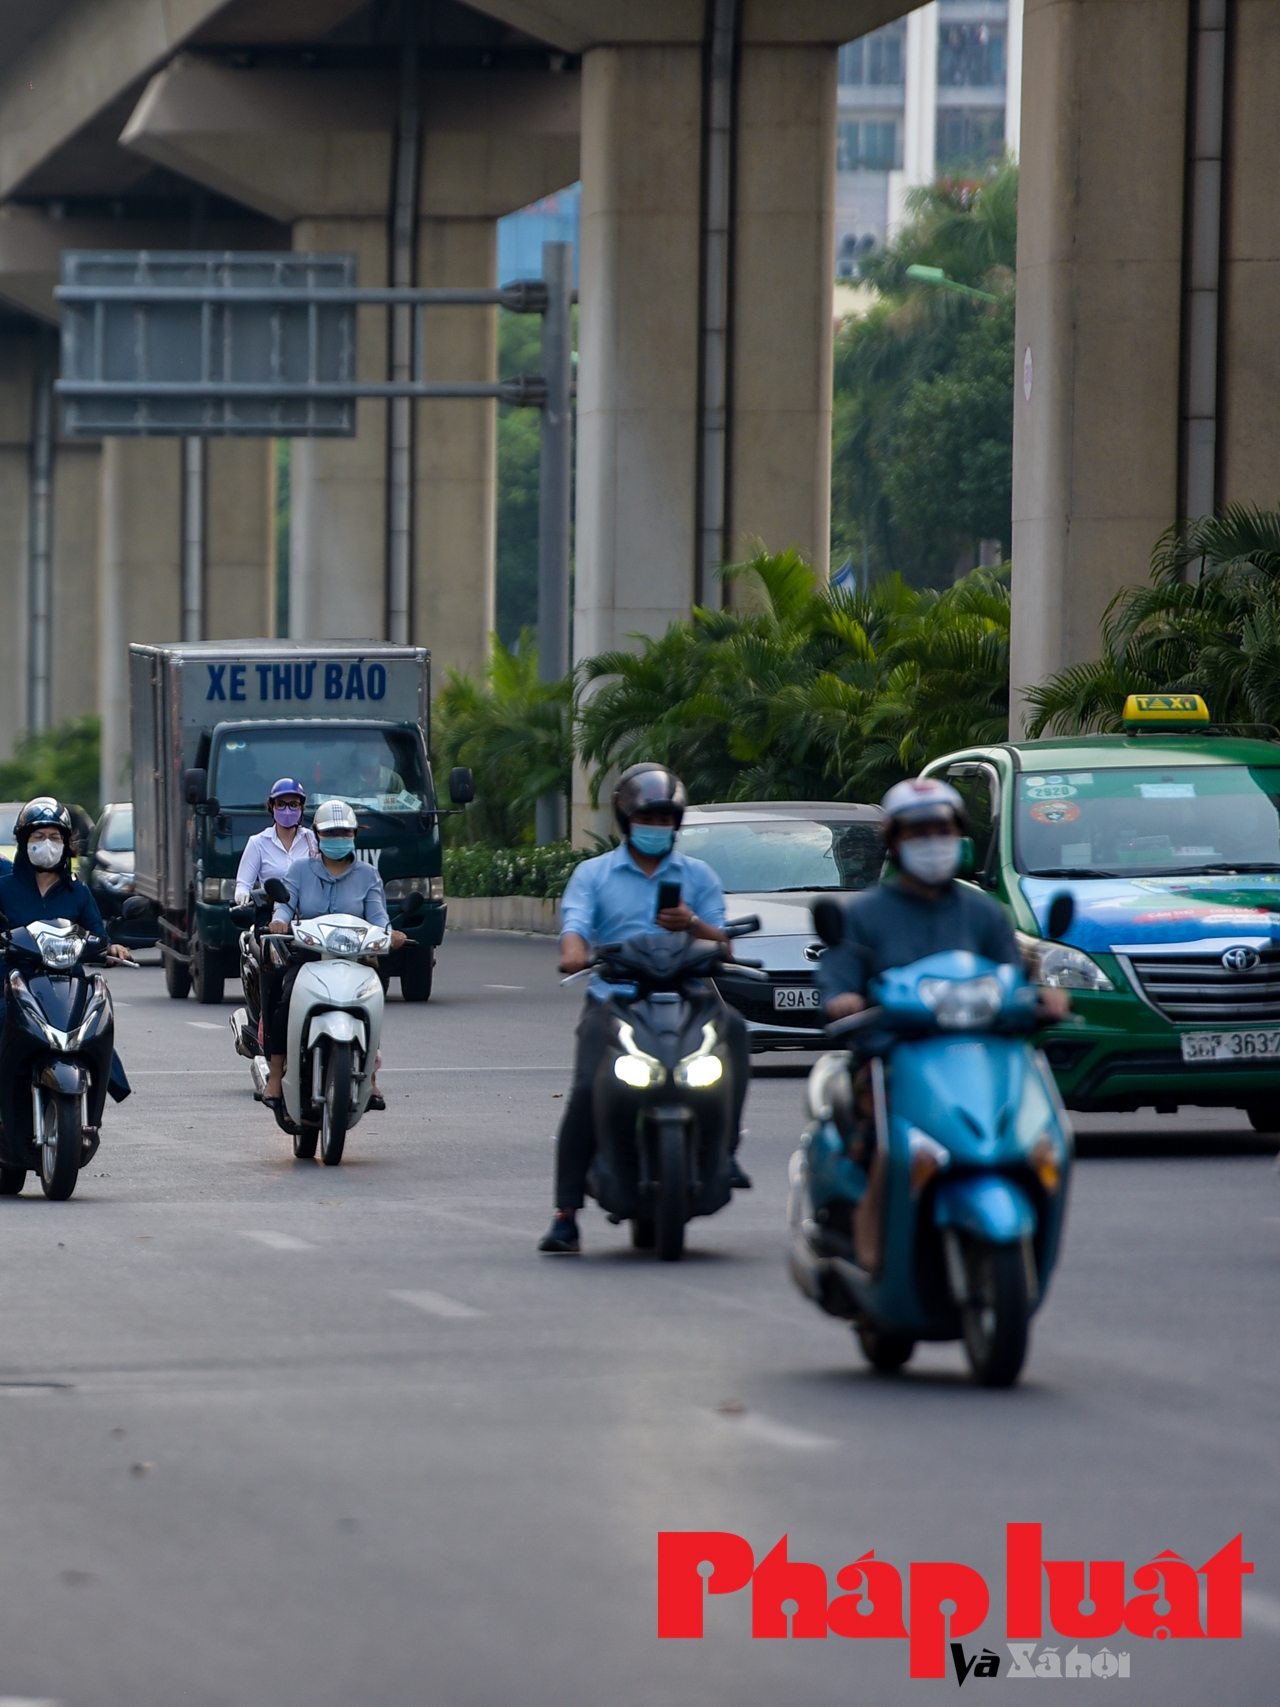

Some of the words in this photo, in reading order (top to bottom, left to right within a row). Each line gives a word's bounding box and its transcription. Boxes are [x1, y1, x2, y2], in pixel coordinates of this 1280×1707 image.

[206, 664, 247, 700] XE
[255, 660, 317, 700] THƯ
[324, 656, 386, 700] BÁO
[1034, 786, 1070, 797] 2920
